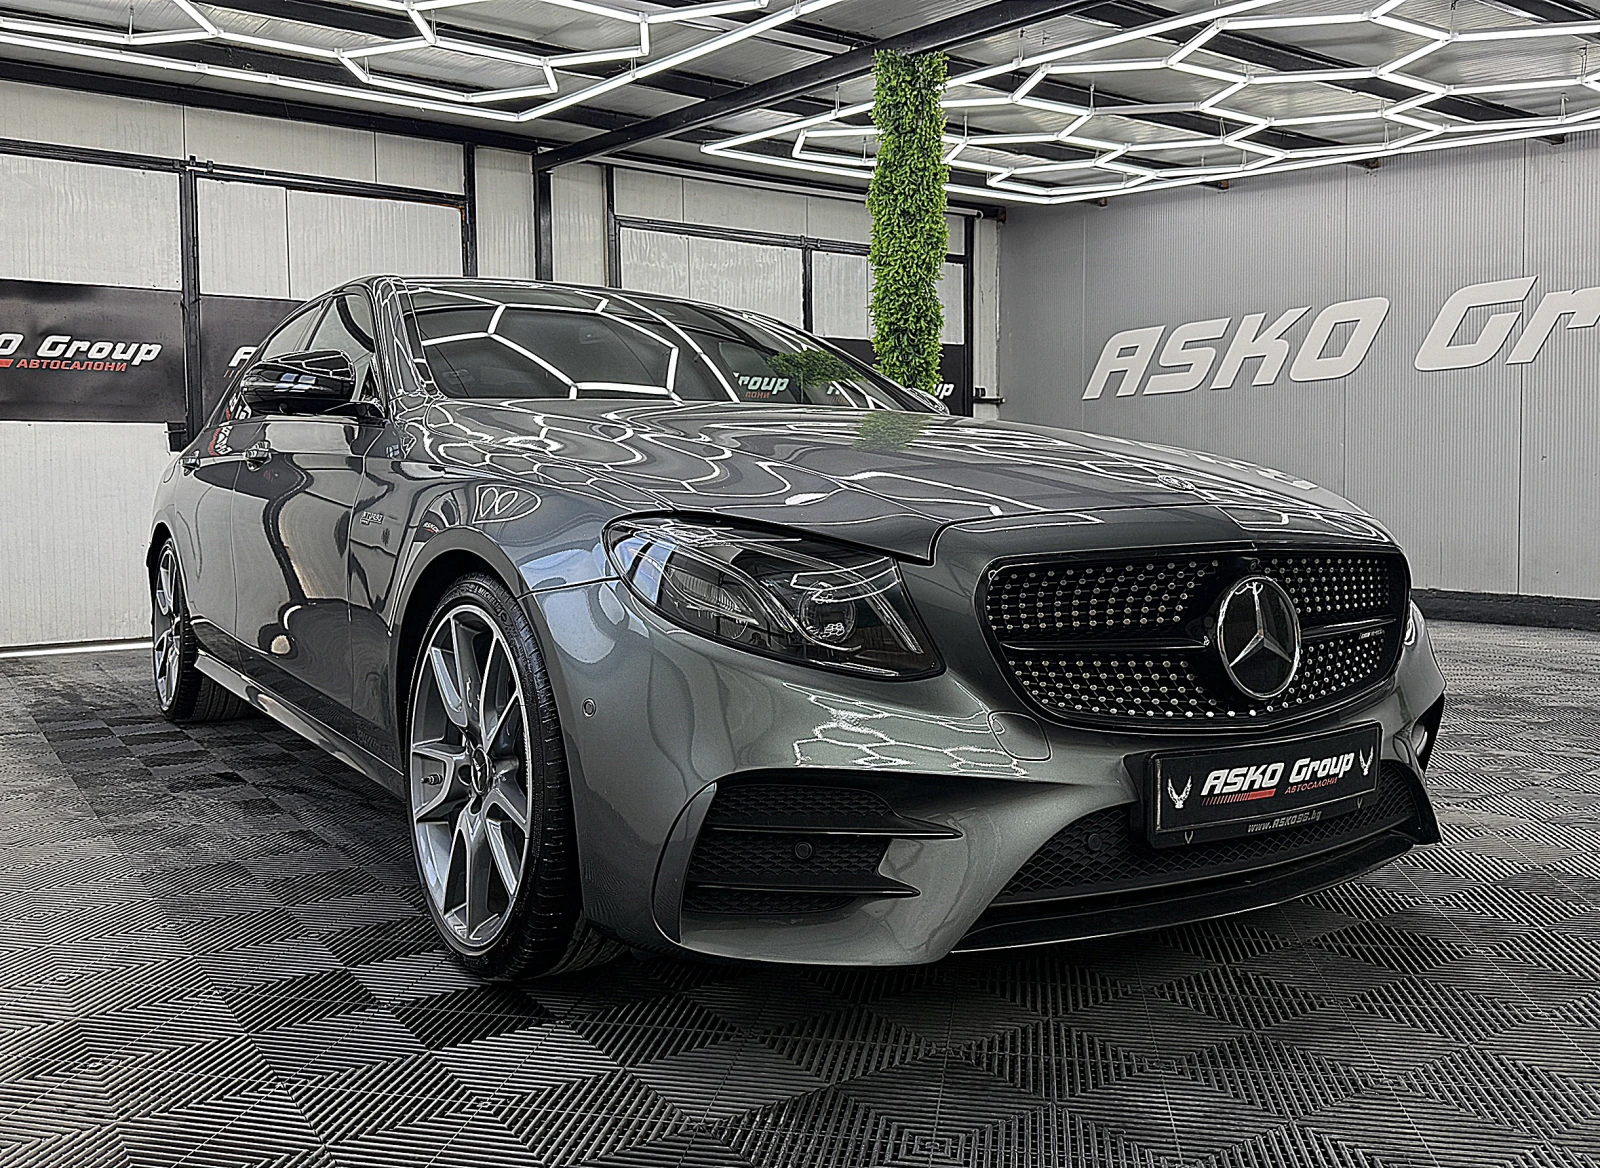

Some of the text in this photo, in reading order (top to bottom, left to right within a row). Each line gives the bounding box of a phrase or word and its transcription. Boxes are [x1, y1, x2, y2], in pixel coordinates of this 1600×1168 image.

[36, 335, 162, 366] Group
[1082, 297, 1390, 400] ASKO
[16, 359, 127, 372] АВТОСАЛОНИ
[733, 372, 789, 395] roup
[1201, 752, 1355, 796] ASKO Group
[1285, 776, 1338, 795] АВТОСАЛОНИ
